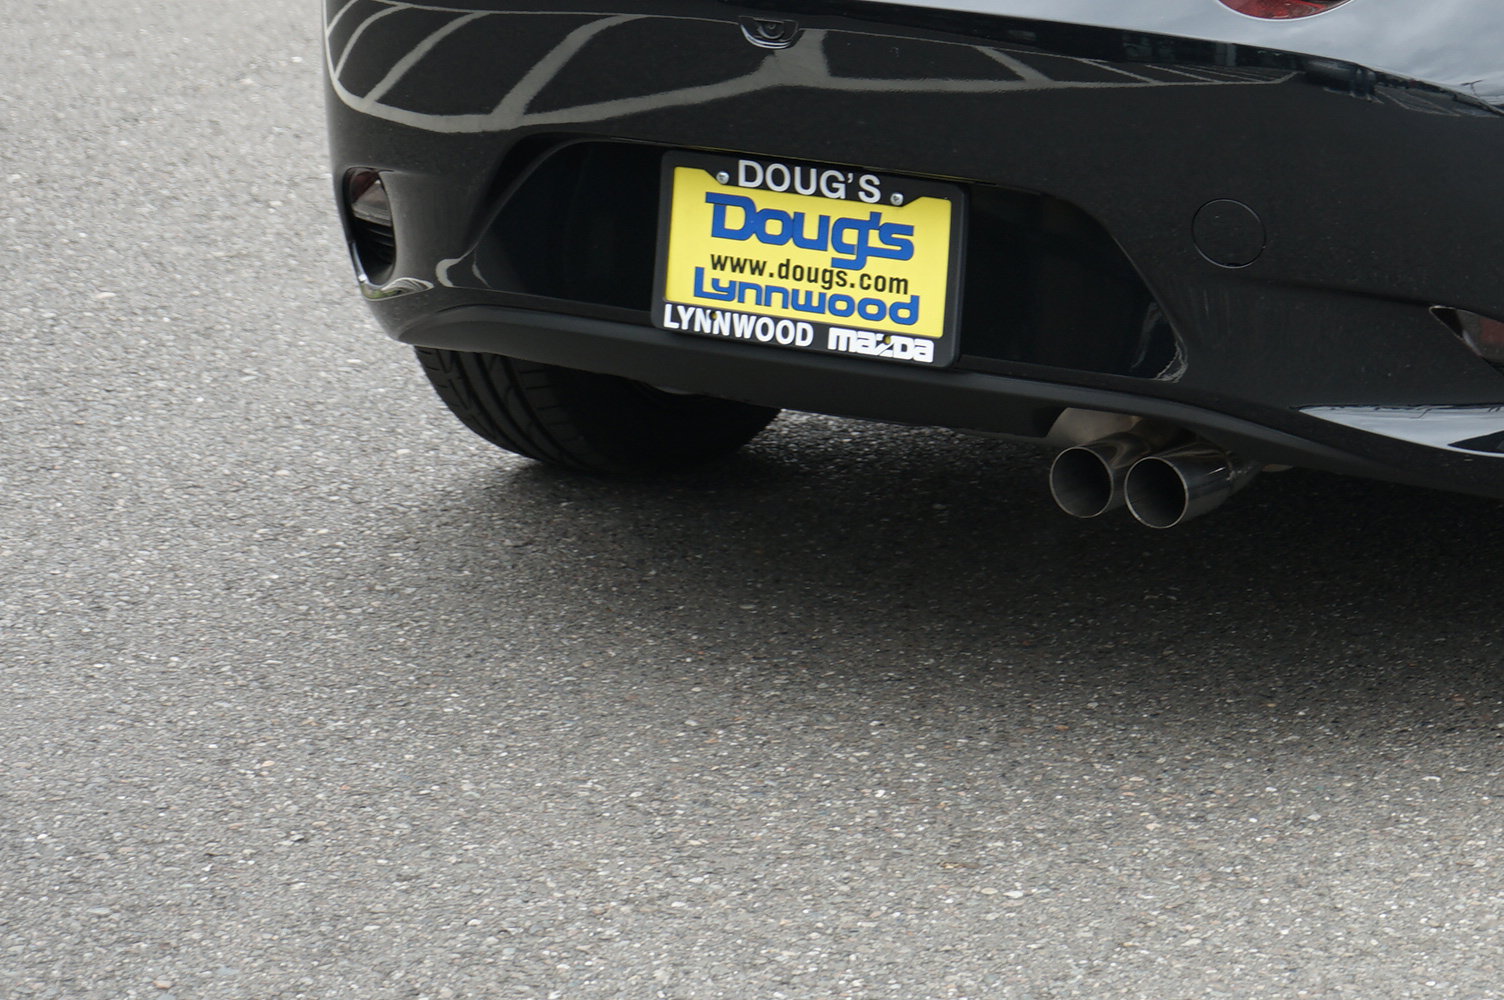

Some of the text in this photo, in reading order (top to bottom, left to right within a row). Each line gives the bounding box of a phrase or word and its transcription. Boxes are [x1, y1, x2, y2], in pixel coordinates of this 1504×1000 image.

[738, 159, 882, 204] DOUG'S
[693, 266, 920, 326] Lynnwood
[710, 254, 909, 296] www.dougs.com
[663, 303, 814, 347] LYNNWOOD
